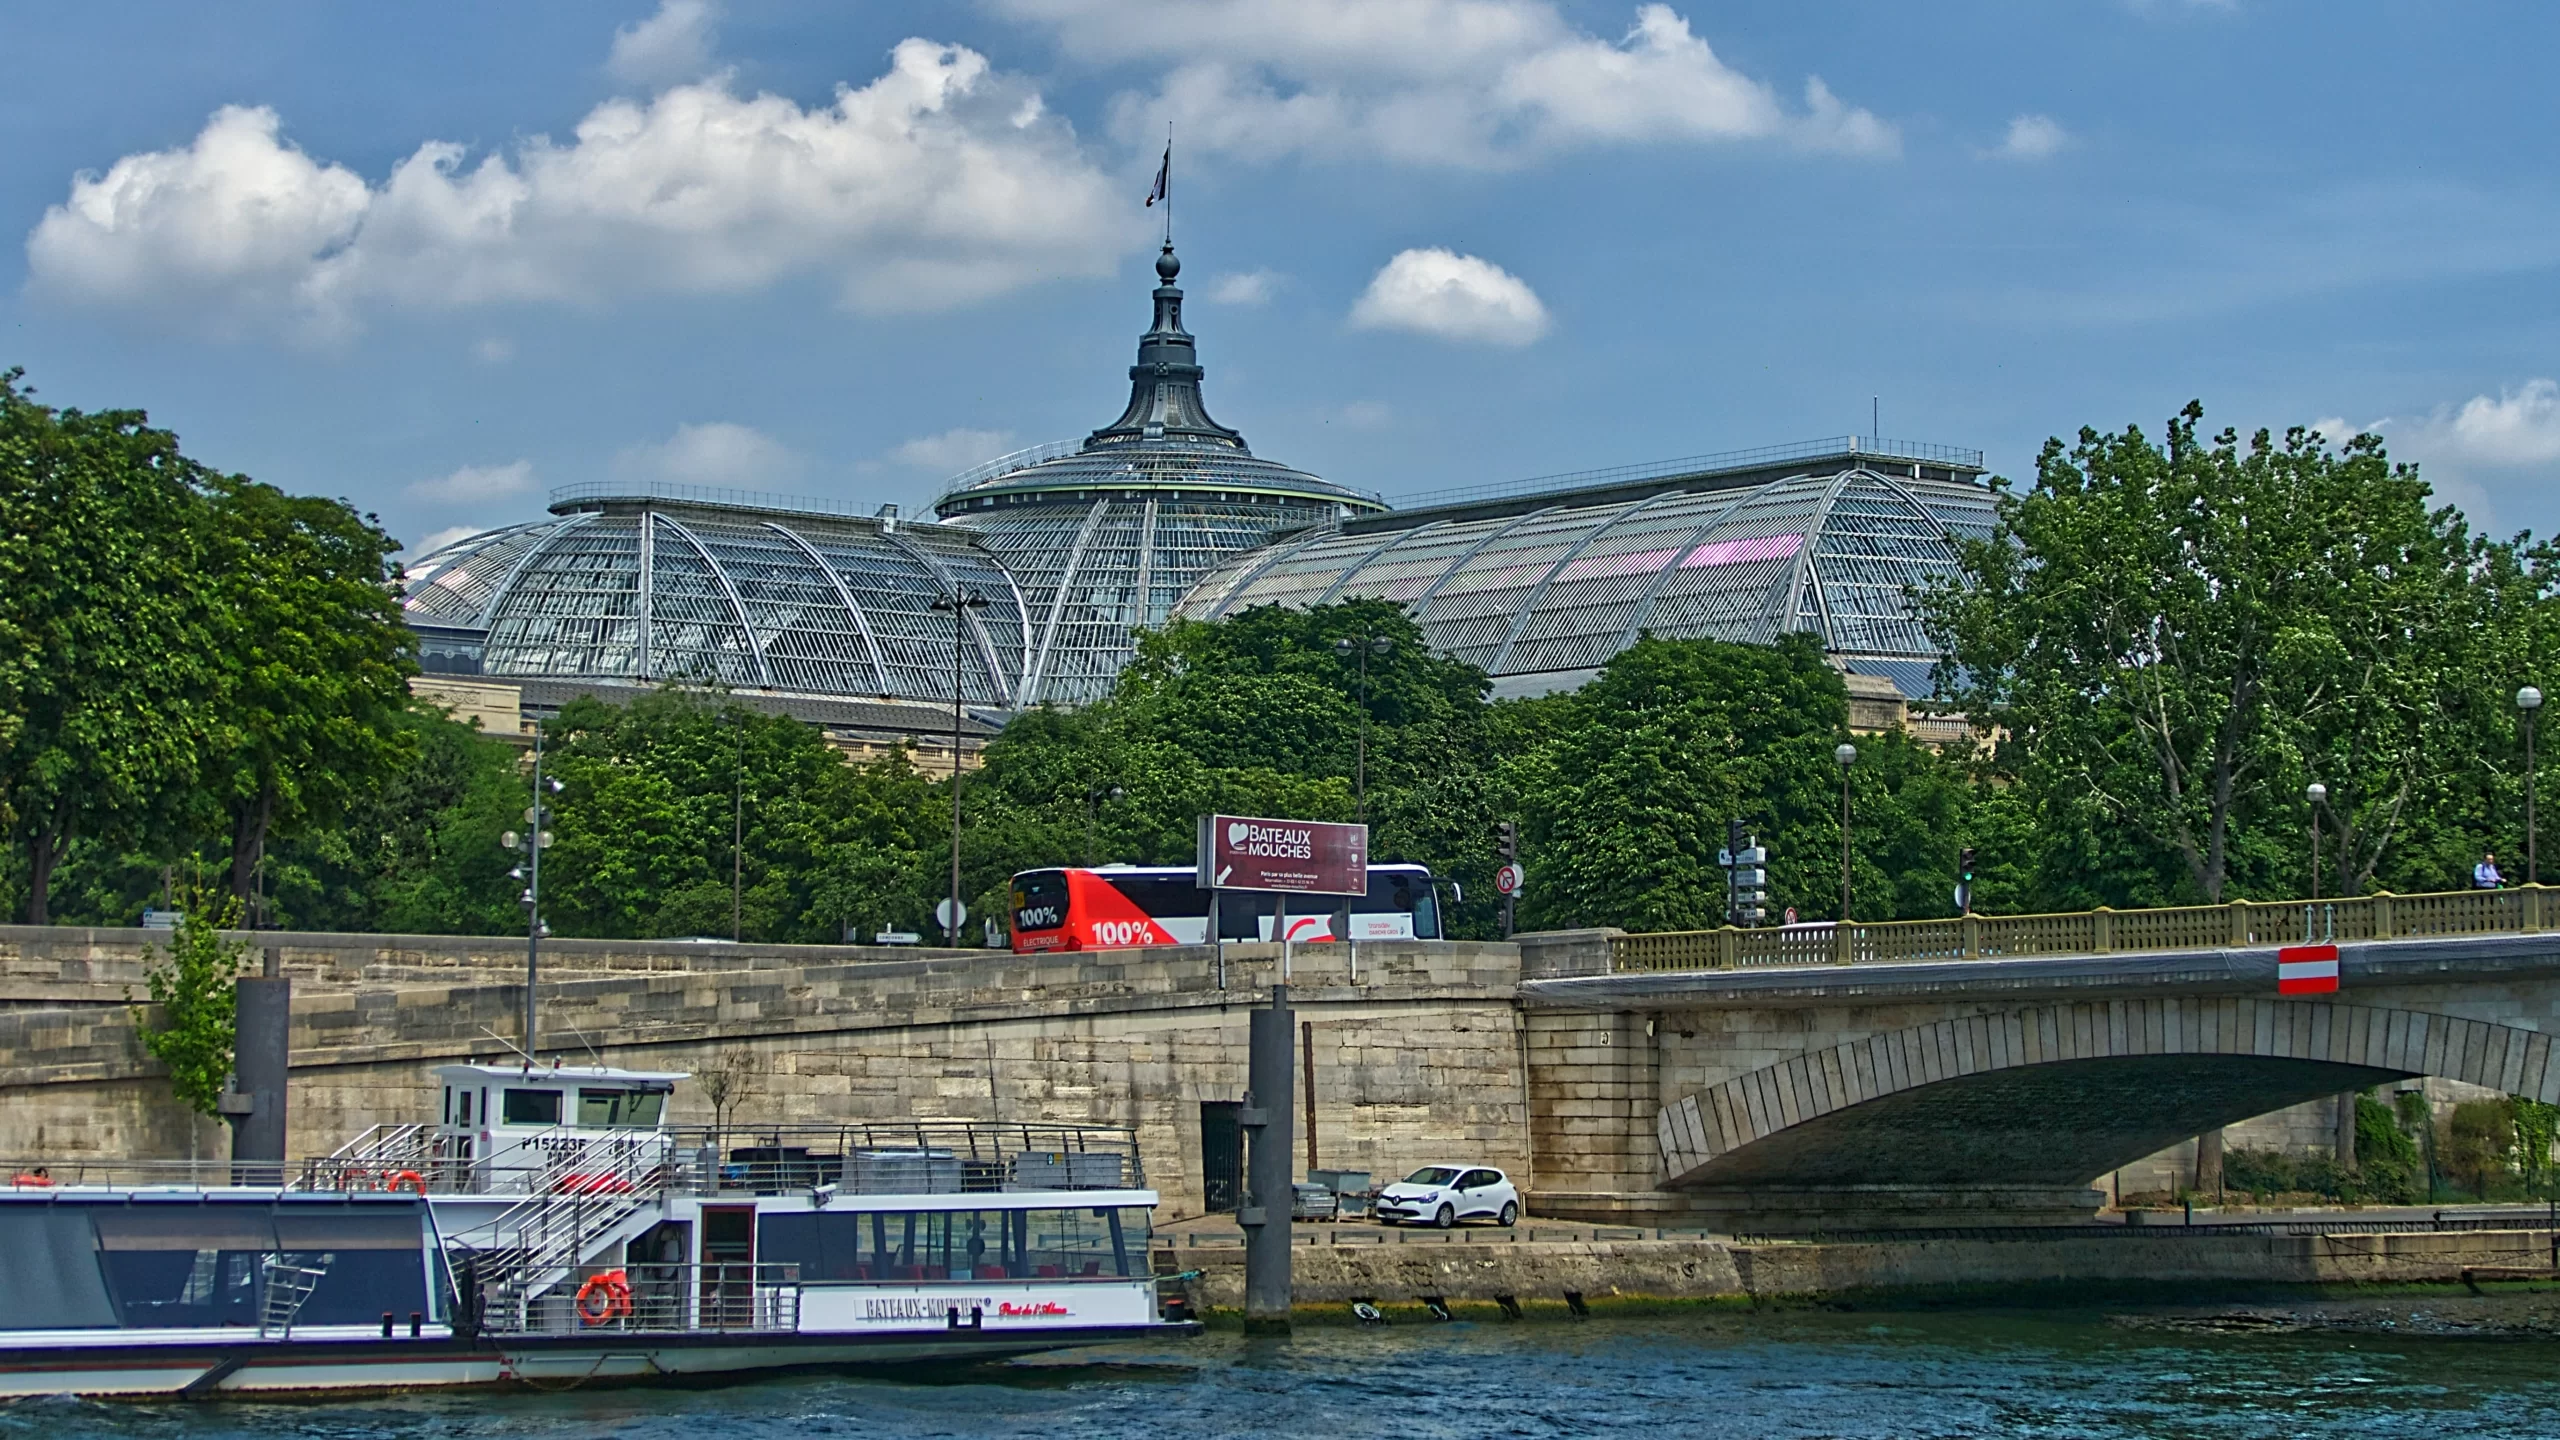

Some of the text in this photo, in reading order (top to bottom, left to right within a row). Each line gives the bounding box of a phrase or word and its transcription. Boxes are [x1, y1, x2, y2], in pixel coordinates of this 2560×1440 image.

[1249, 825, 1311, 845] BATEAUX
[1248, 843, 1311, 859] MOUCHES
[1019, 906, 1058, 927] 100%
[1023, 935, 1059, 947] ÉLECTRIQUE
[1092, 921, 1154, 945] 100%
[521, 1137, 587, 1151] P15223F
[1022, 1303, 1032, 1315] de
